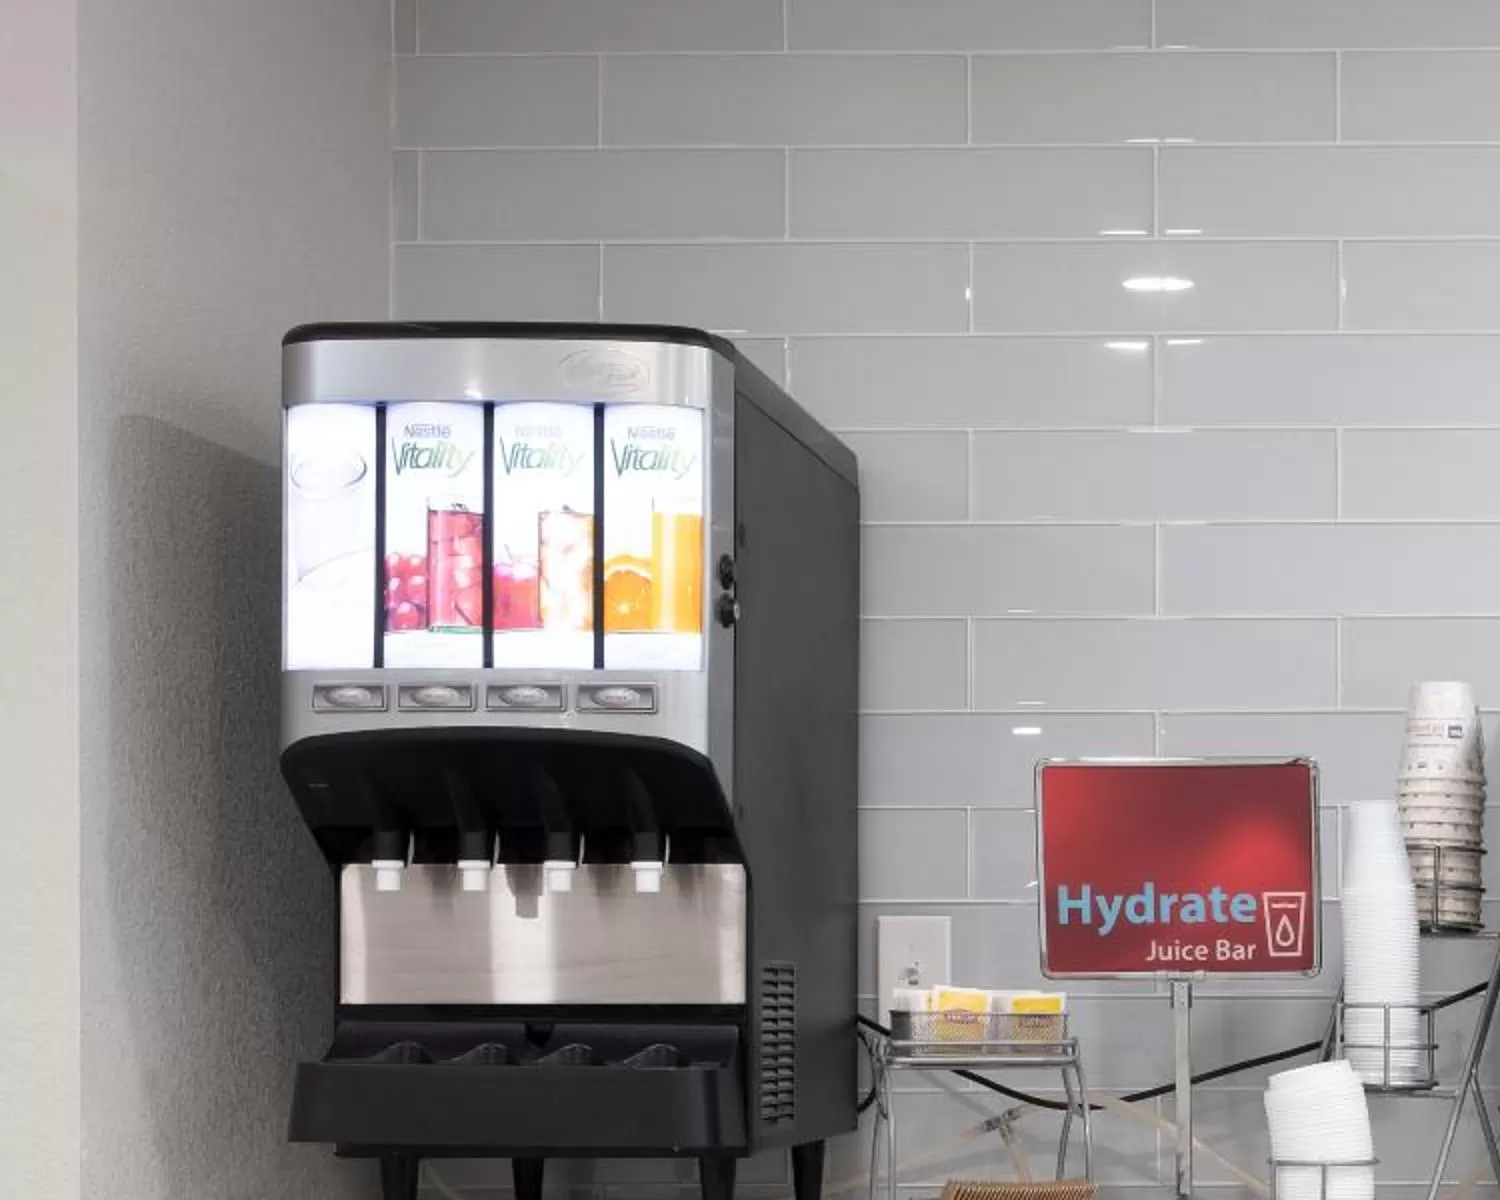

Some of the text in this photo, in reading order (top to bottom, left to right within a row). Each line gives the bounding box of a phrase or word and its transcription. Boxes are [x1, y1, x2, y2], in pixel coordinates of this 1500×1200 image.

[391, 434, 476, 477] Vitality
[499, 434, 586, 477] Vitality
[609, 435, 698, 481] Vitality
[1056, 881, 1258, 937] Hydrate
[1145, 939, 1257, 961] Juice Bar
